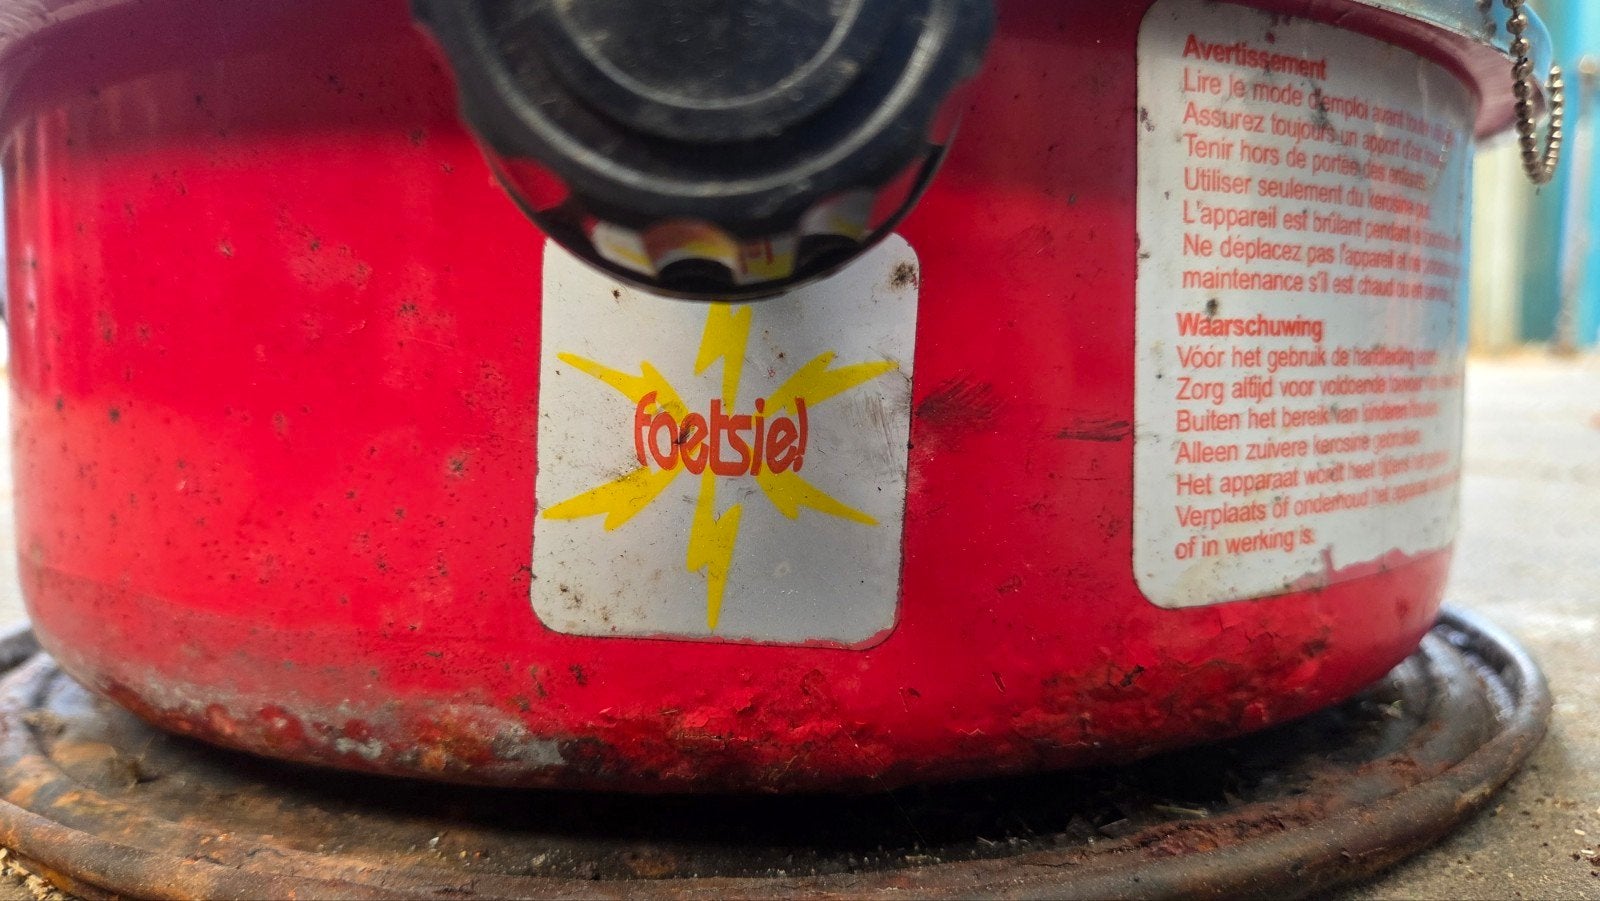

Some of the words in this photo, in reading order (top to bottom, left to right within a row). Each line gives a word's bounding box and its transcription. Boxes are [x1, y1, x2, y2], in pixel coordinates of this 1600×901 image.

[1182, 33, 1327, 81] Avertissement
[1183, 68, 1222, 95] Lire
[1228, 73, 1246, 97] le
[1253, 80, 1303, 106] mode
[1308, 89, 1368, 121] d'emploi
[1372, 105, 1405, 128] avant
[1183, 101, 1264, 133] Assurez
[1271, 113, 1335, 144] toujours
[1340, 130, 1357, 146] un
[1363, 132, 1399, 155] apport
[1183, 133, 1234, 160] Tenir
[1240, 137, 1279, 165] hors
[1286, 146, 1306, 169] de
[1364, 161, 1387, 179] des
[1183, 167, 1251, 193] Utiliser
[1257, 176, 1342, 203] seulement
[1346, 187, 1363, 206] du
[1182, 199, 1277, 228] L'appareil
[1282, 211, 1309, 230] est
[1313, 211, 1362, 237] brûlant
[1365, 219, 1411, 243] pendant
[1182, 233, 1212, 256] Ne
[1219, 234, 1301, 264] déplacez
[1307, 245, 1334, 267] pas
[1339, 242, 1393, 270] l'appareil
[1182, 266, 1303, 290] maintenance
[1309, 269, 1327, 292] s'il
[1333, 273, 1354, 293] est
[1358, 273, 1393, 296] chaud
[1176, 312, 1325, 343] Waarschuwing
[1176, 344, 1225, 369] Vóór
[1232, 345, 1261, 368] het
[1267, 345, 1326, 373] gebruik
[1331, 346, 1348, 367] de
[1353, 345, 1414, 369] handleiding
[1176, 376, 1225, 405] Zorg
[1232, 376, 1273, 404] altijd
[1279, 379, 1315, 397] voor
[1320, 374, 1387, 397] voldoende
[1176, 408, 1240, 433] Buiten
[1249, 407, 1276, 430] het
[1282, 405, 1330, 428] bereik
[1335, 406, 1357, 424] van
[1175, 441, 1239, 465] Alleen
[1246, 438, 1307, 461] zuivere
[1313, 431, 1370, 456] kerosine
[1175, 473, 1212, 496] Het
[1219, 468, 1299, 497] apparaat
[1304, 462, 1344, 486] wordt
[1348, 459, 1375, 480] heet
[1175, 502, 1267, 530] Verplaats
[1272, 497, 1290, 519] of
[1294, 487, 1370, 516] onderhoud
[1372, 487, 1389, 505] het
[1175, 537, 1197, 560] of
[1202, 535, 1218, 556] in
[1225, 529, 1294, 555] werking
